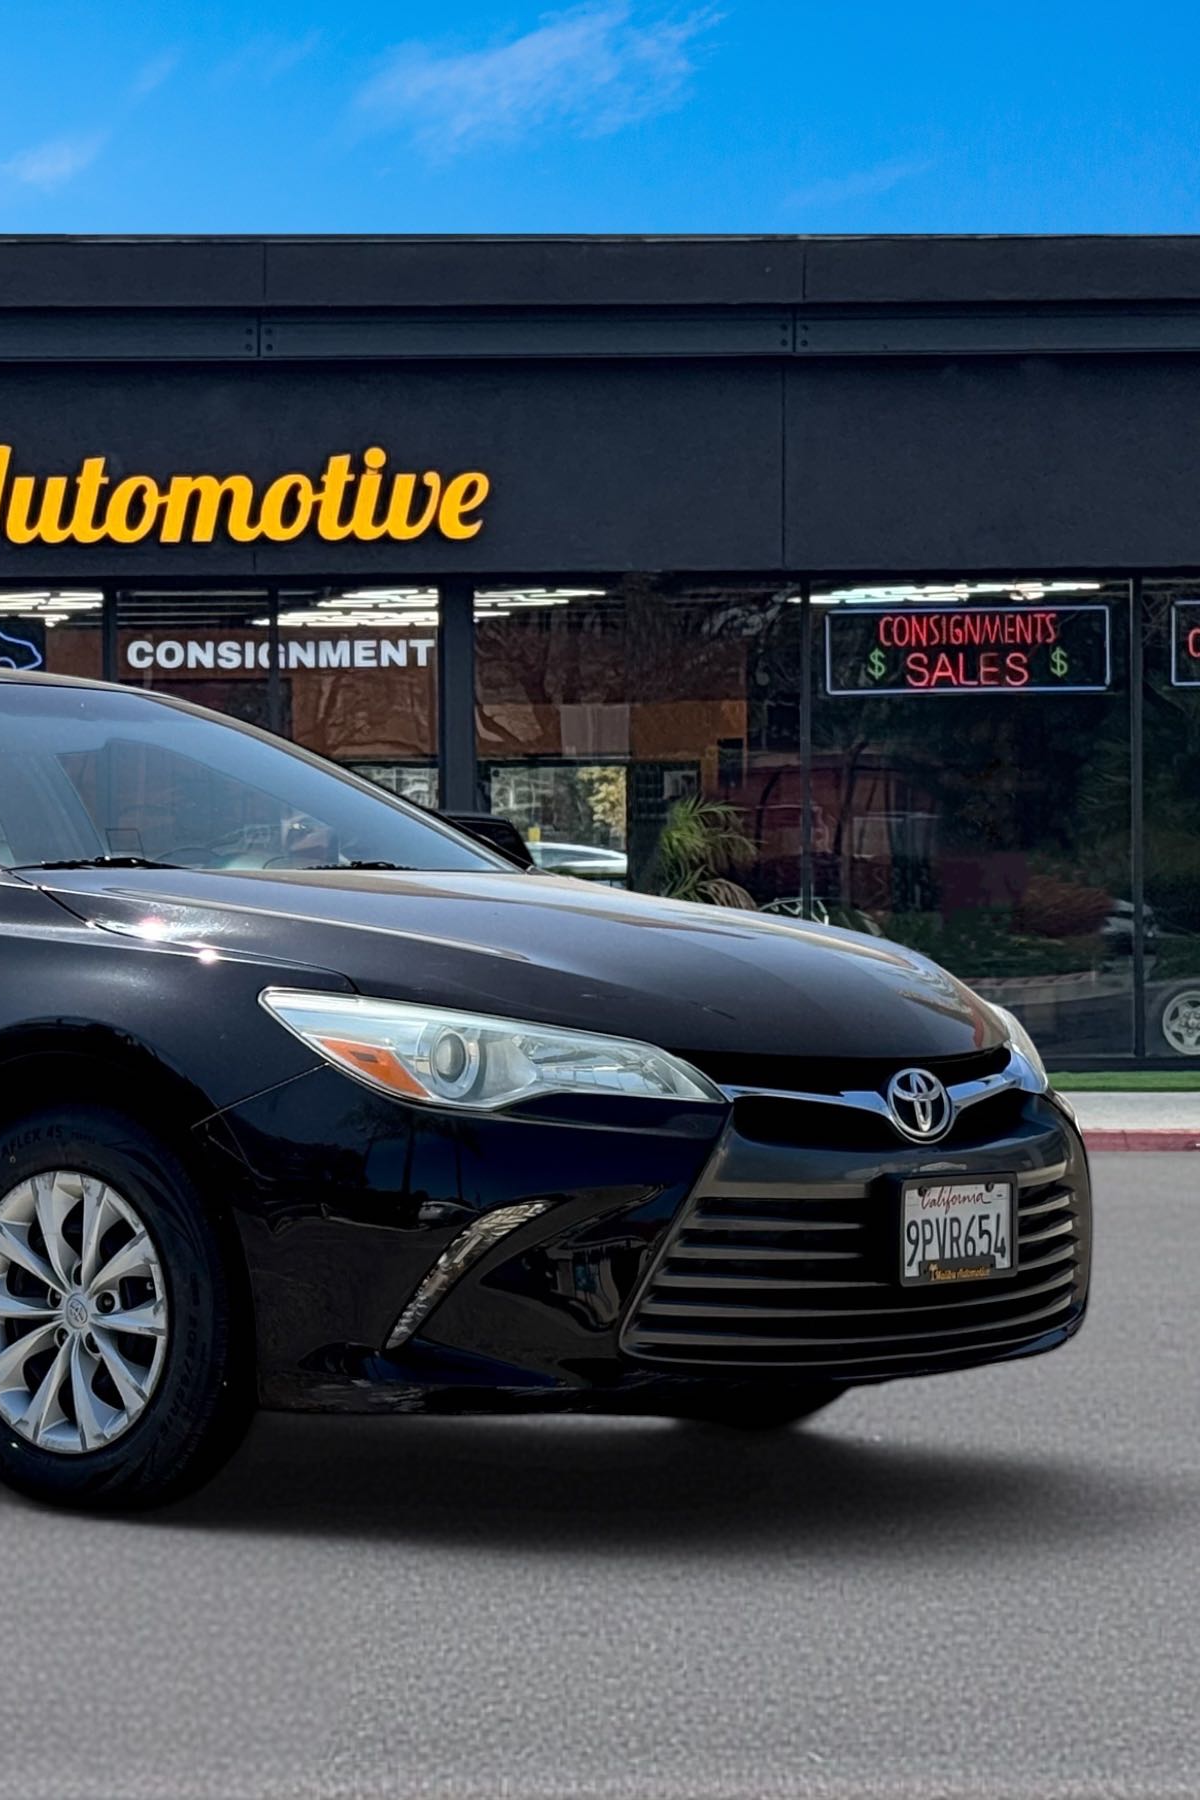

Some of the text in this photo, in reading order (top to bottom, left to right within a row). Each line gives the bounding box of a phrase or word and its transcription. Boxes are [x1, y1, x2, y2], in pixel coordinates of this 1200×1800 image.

[879, 613, 1058, 648] CONSIGNMENTS
[126, 639, 435, 669] CONSIGNMENT
[906, 652, 1030, 687] SALES
[921, 1185, 992, 1215] California
[906, 1213, 1007, 1268] 9PVR654
